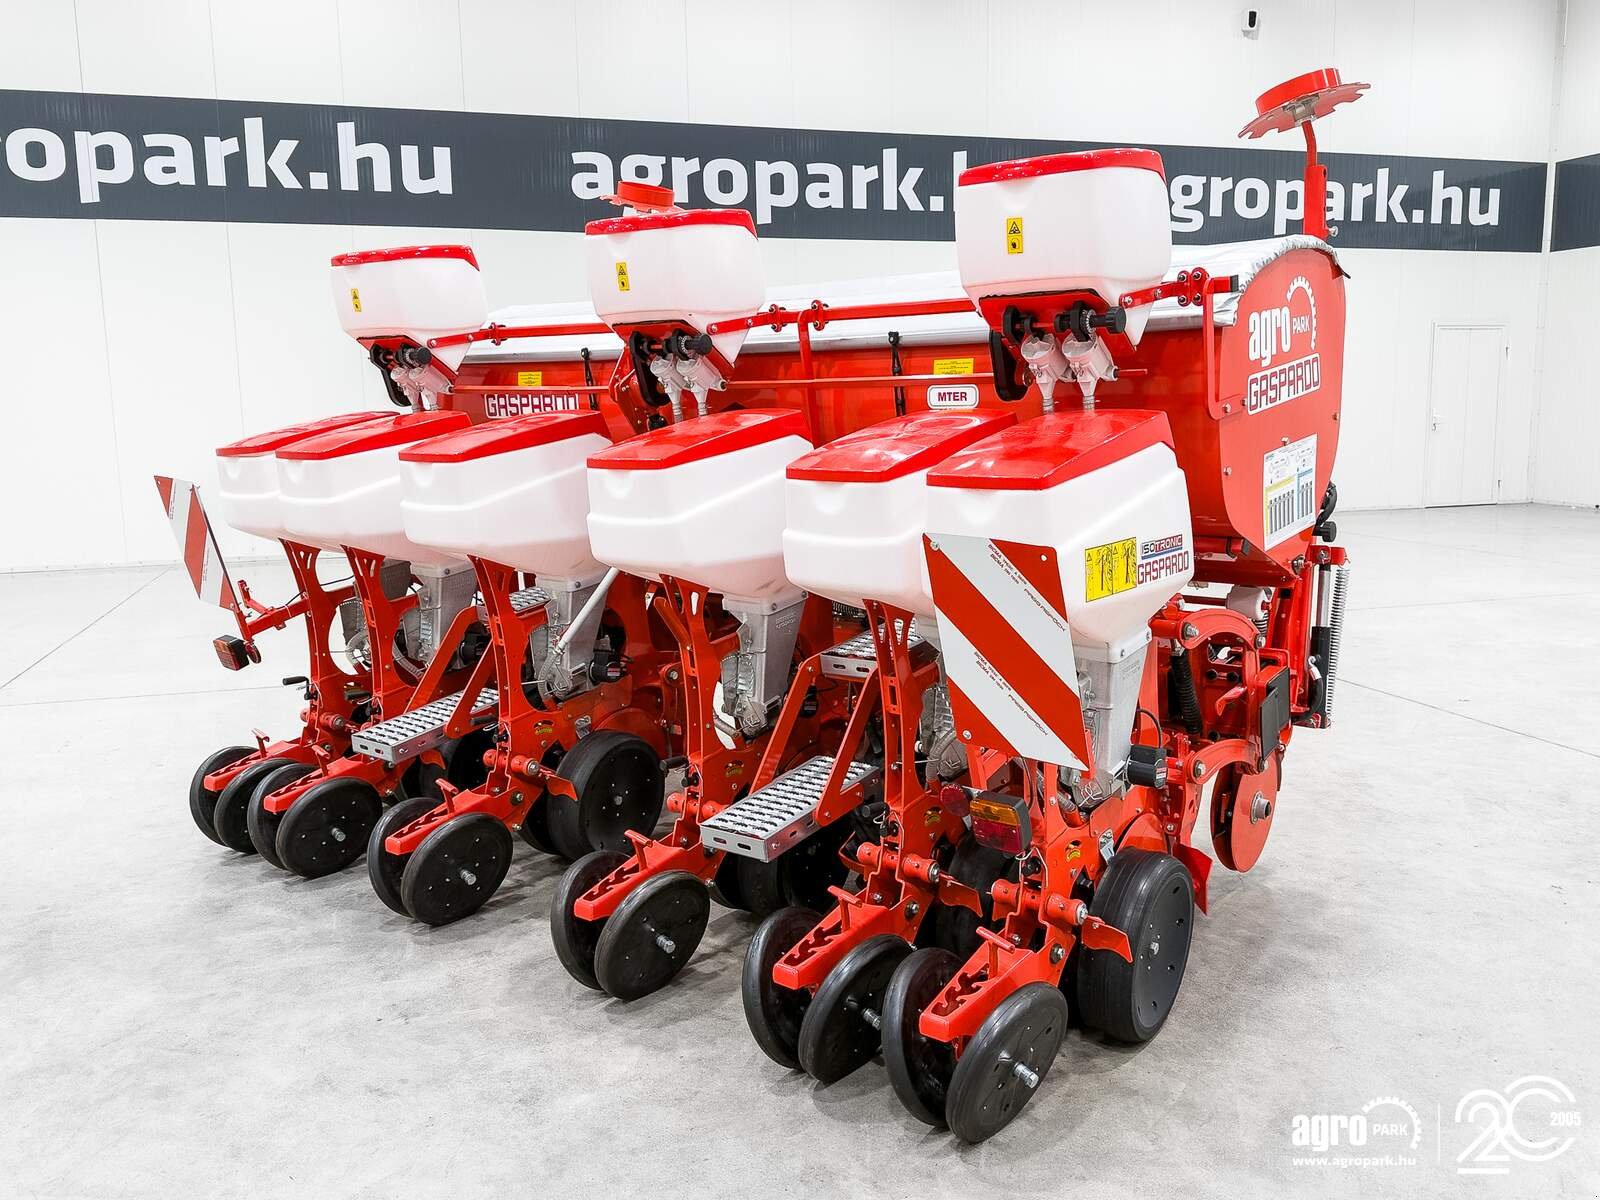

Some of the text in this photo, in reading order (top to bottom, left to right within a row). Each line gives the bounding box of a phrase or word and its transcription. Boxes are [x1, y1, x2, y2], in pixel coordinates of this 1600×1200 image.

[0, 116, 453, 204] opark.hu
[571, 148, 967, 223] agropark.
[1169, 167, 1500, 235] gropark.hu
[1249, 306, 1310, 367] agro PARK
[485, 393, 578, 417] GASPARDO
[938, 391, 968, 402] MTER
[1249, 357, 1319, 412] GASPARDO
[1138, 551, 1190, 585] GASPARDO
[1142, 534, 1183, 555] ISOTRONIC
